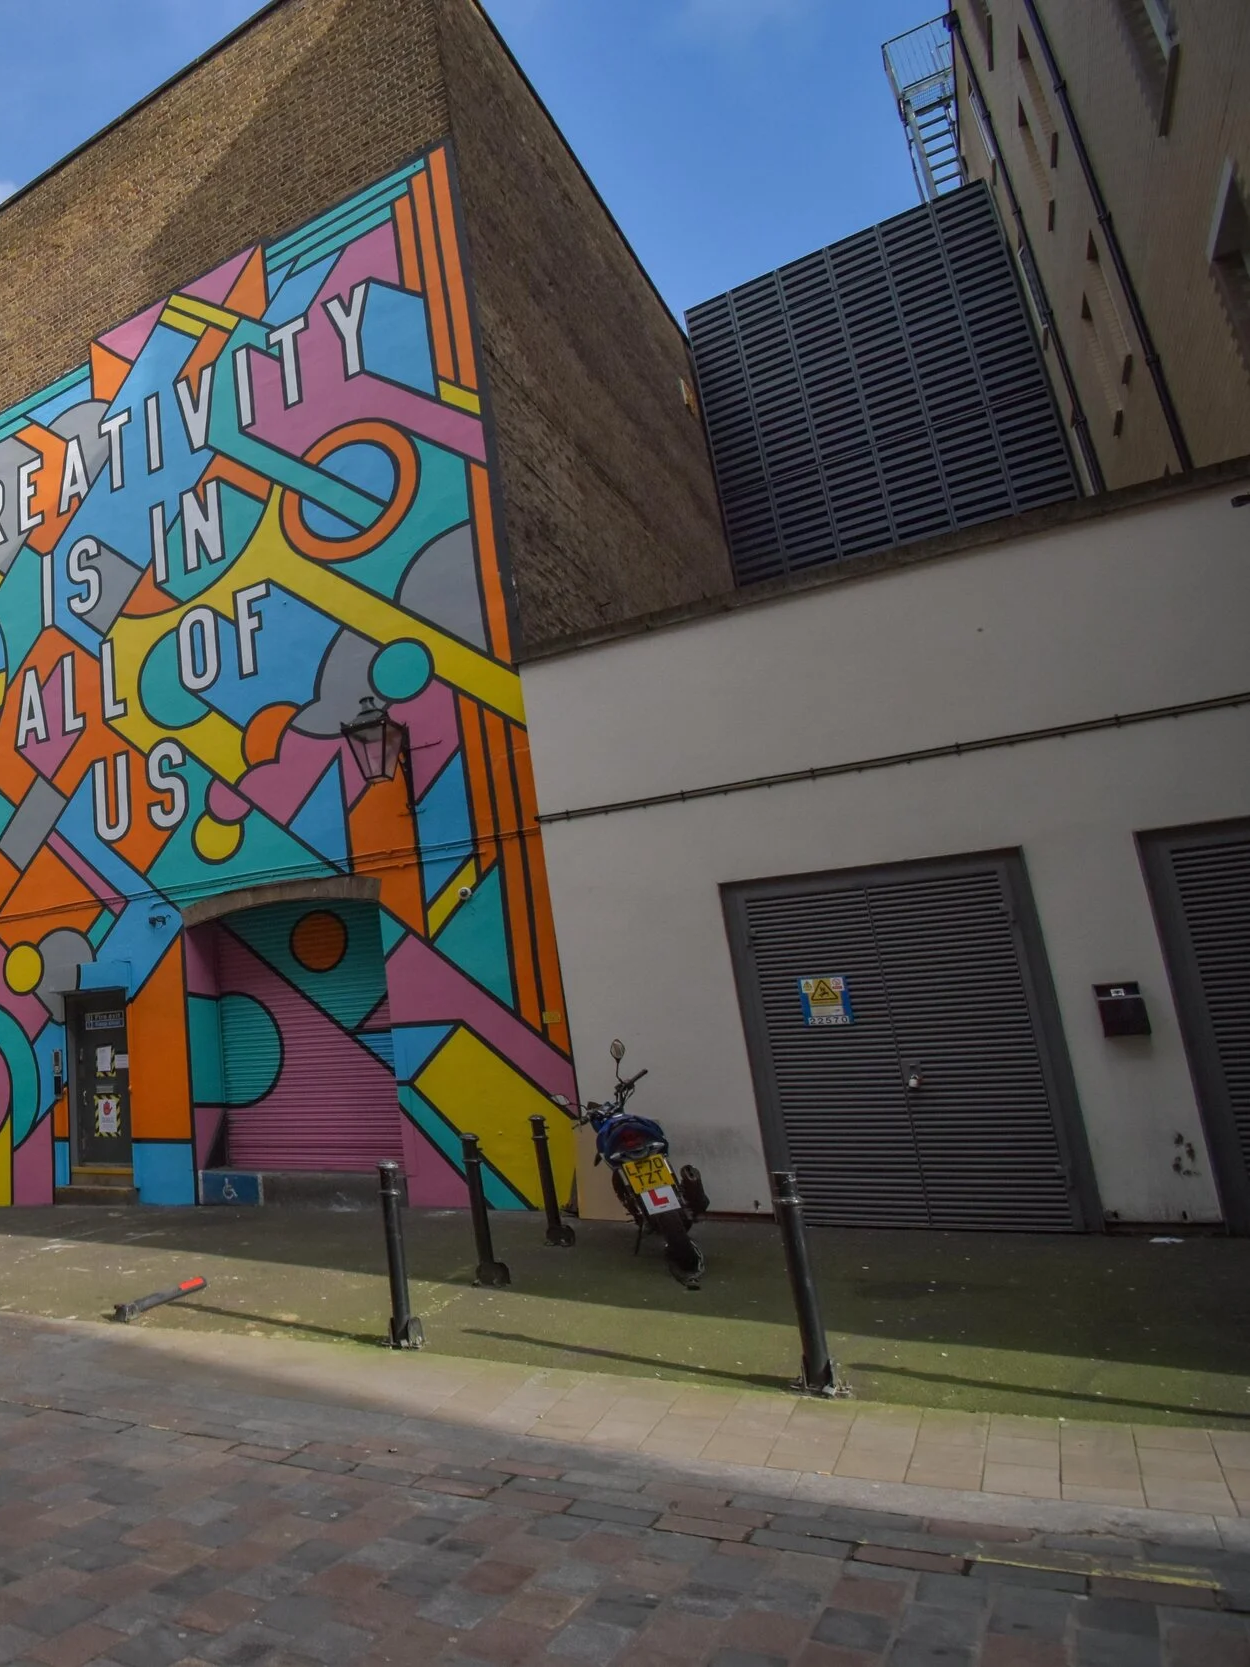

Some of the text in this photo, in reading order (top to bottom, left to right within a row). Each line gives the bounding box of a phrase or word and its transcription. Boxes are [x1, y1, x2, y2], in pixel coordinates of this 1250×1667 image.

[41, 478, 225, 627] IS IN
[16, 579, 270, 749] ALL OF
[93, 739, 188, 841] US
[810, 1016, 848, 1025] 22570
[635, 1169, 664, 1186] TZT
[648, 1188, 670, 1207] L
